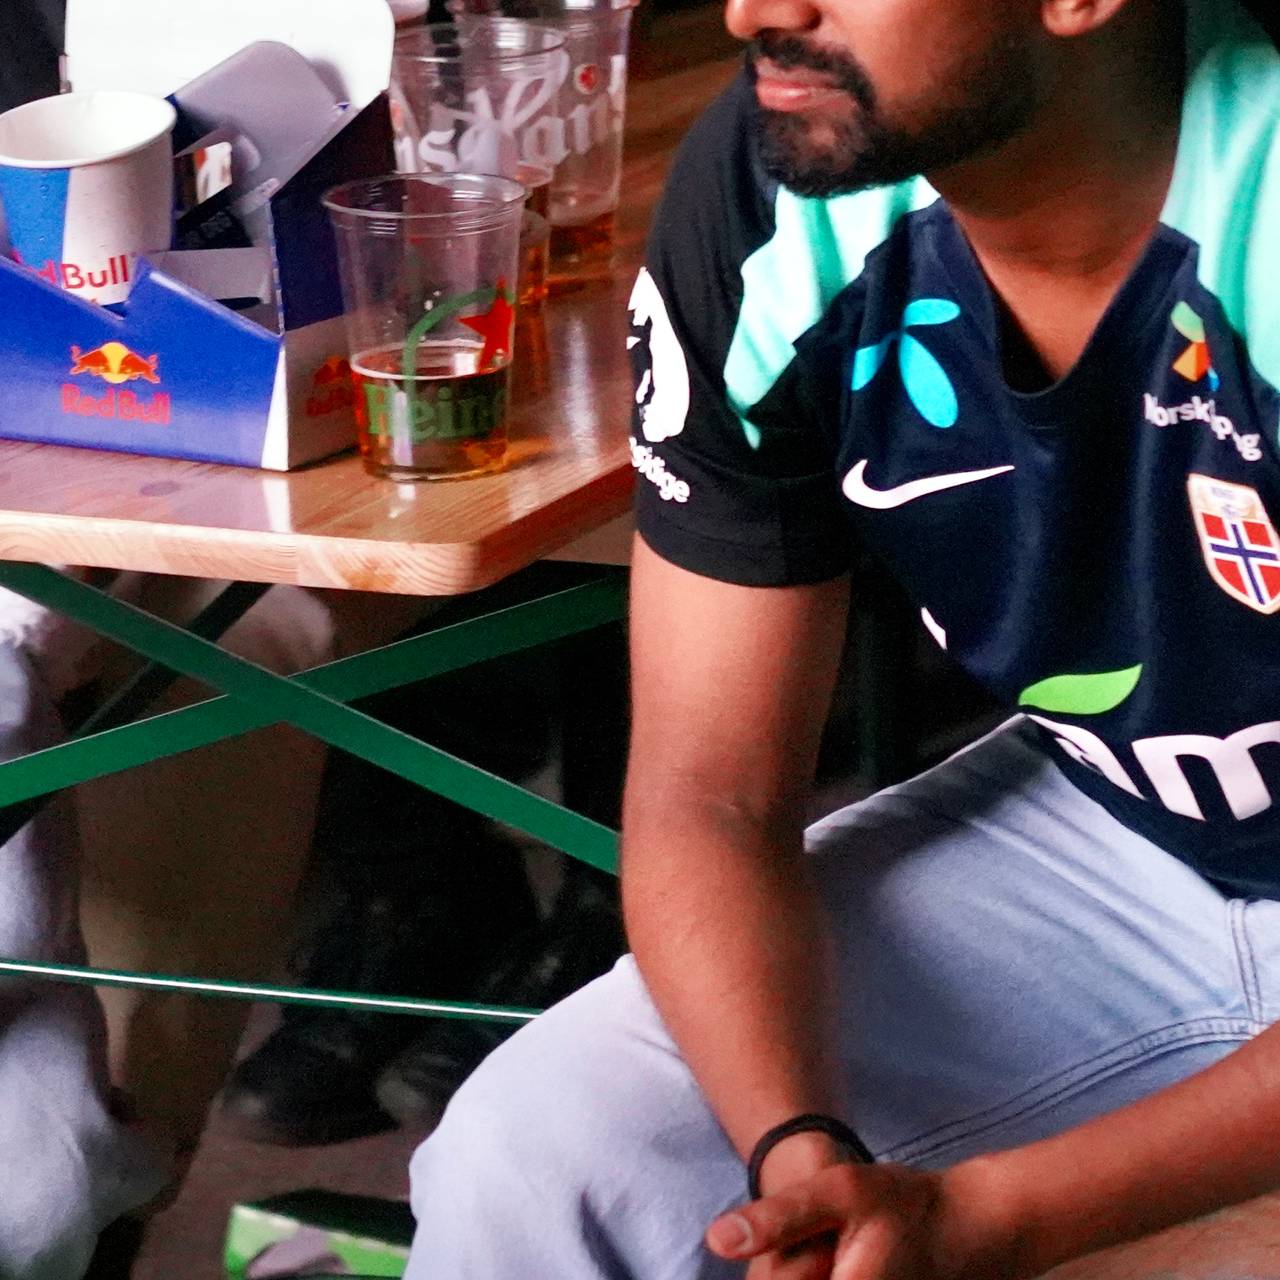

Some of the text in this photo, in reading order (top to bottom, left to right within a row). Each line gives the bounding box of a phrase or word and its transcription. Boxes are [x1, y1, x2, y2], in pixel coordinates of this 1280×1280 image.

[61, 254, 129, 290] Bull
[61, 383, 171, 425] Red Bull
